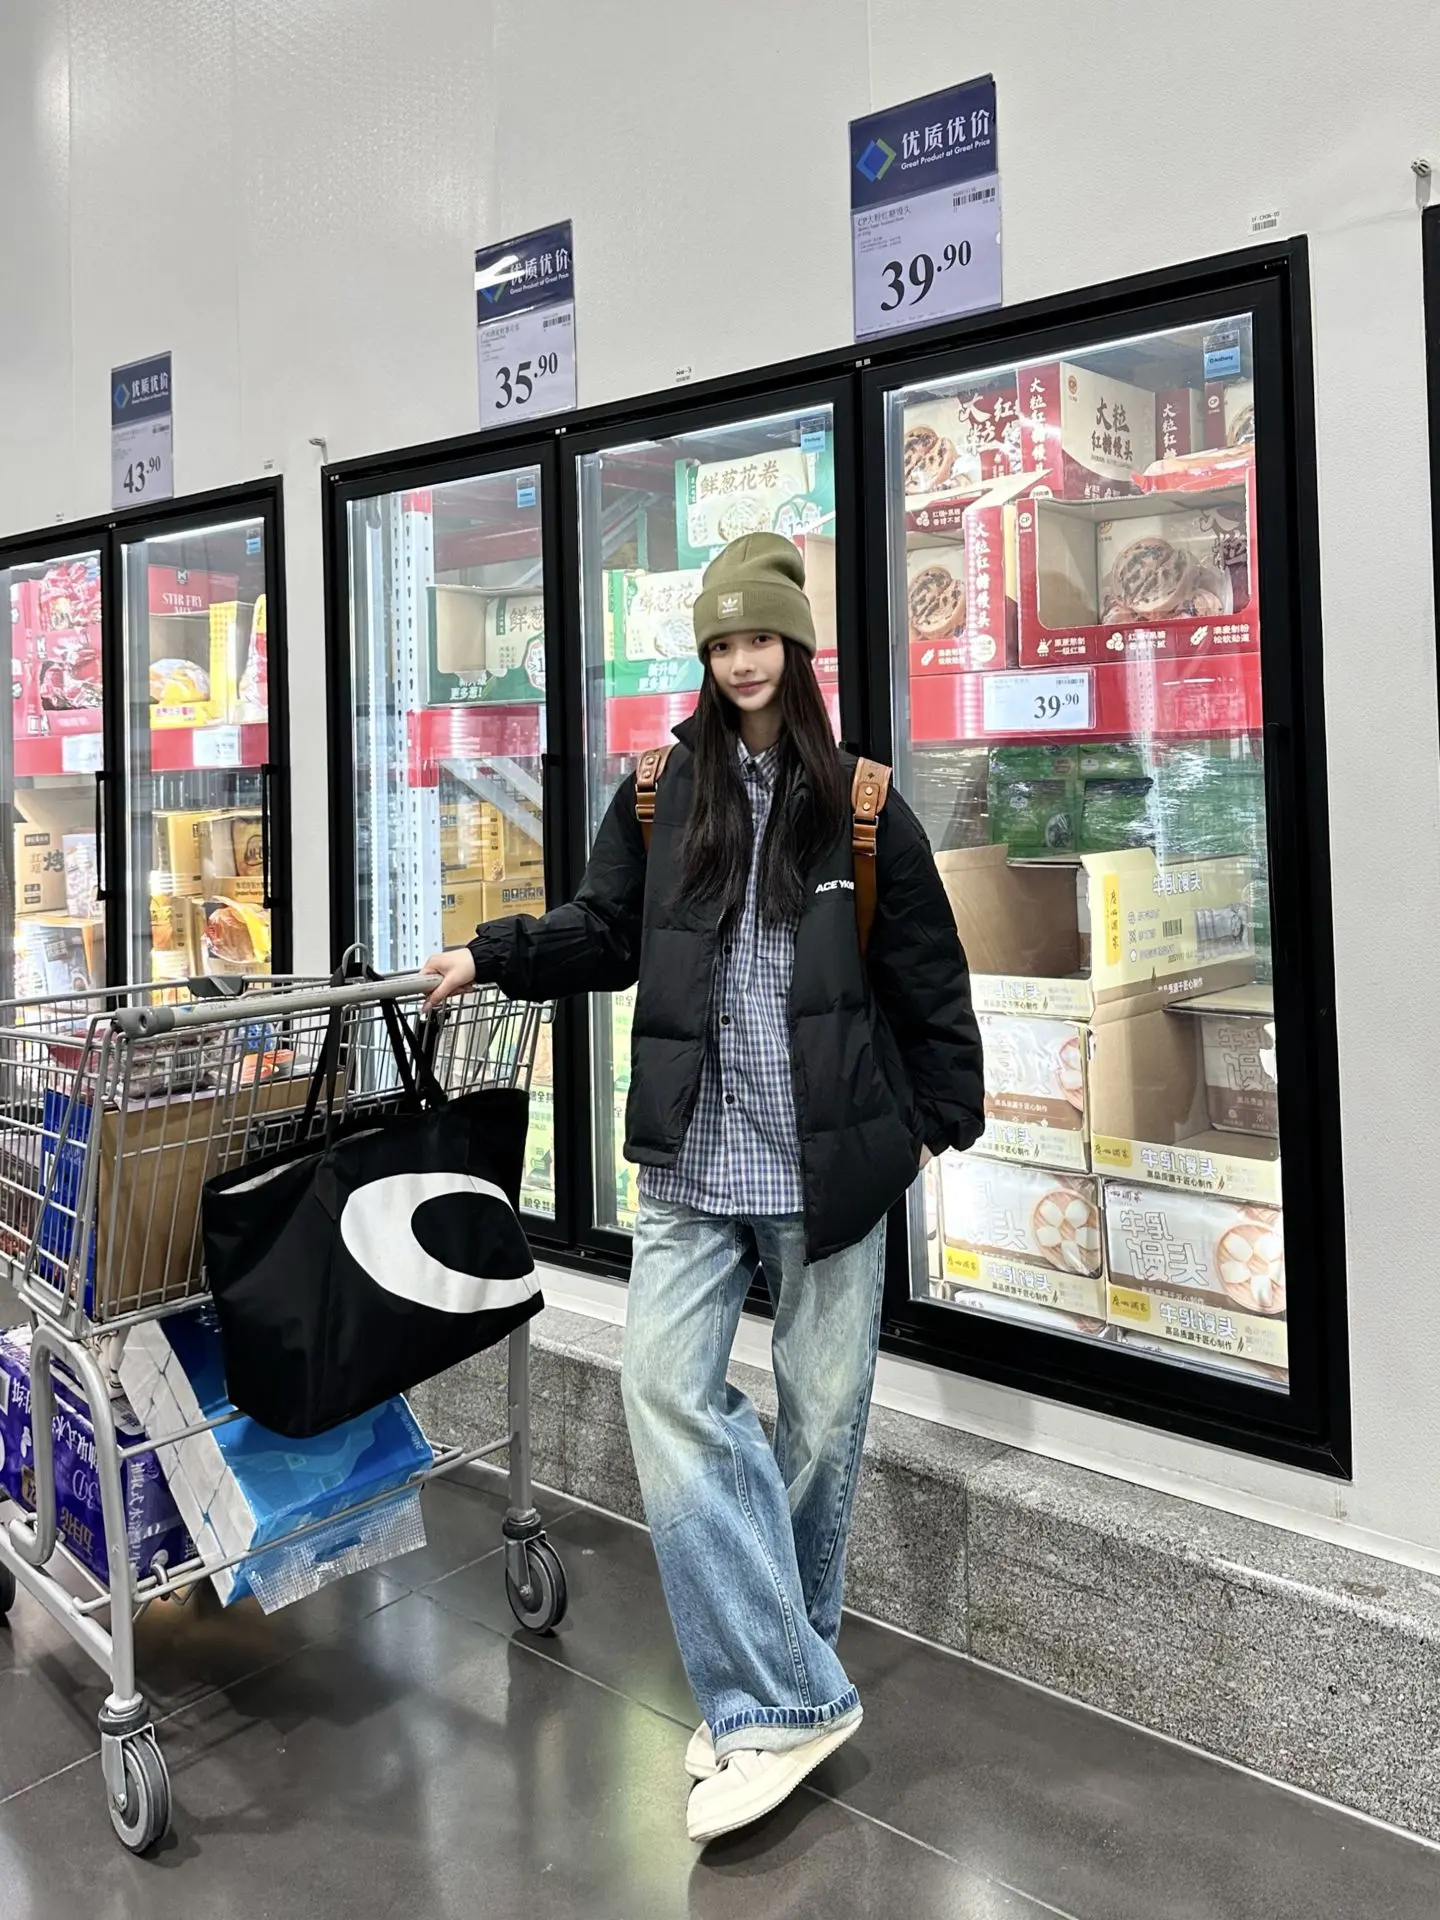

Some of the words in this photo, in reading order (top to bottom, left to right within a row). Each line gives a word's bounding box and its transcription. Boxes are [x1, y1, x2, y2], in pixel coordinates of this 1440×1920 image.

[901, 108, 990, 159] 优质优价
[901, 160, 920, 170] Great
[920, 153, 945, 167] Product
[954, 144, 973, 155] Great
[974, 138, 991, 148] Price
[510, 247, 569, 287] 优质优价
[880, 240, 972, 312] 39.90
[132, 371, 169, 398] 优质优价
[495, 352, 558, 409] 35.90
[1096, 396, 1130, 433] 大粒
[1091, 429, 1134, 463] 红糖馒头
[123, 455, 161, 494] 43.90
[700, 459, 780, 500] 鲜葱花卷
[975, 521, 991, 628] 大粒红糖馒头
[162, 592, 185, 606] STIR
[184, 595, 203, 608] FRY
[509, 605, 544, 633] 鲜葱
[449, 686, 483, 701] 更多葱!
[1033, 693, 1080, 719] 39.90
[815, 880, 838, 894] ACE
[1153, 870, 1202, 897] 牛乳馒头
[1140, 1147, 1218, 1179] 牛乳馒头
[1146, 1169, 1214, 1190] 高品质源于匠心制作
[1120, 1209, 1174, 1241] 牛乳
[988, 1262, 1051, 1292] 牛乳馒头
[1126, 1238, 1209, 1287] 馒头
[992, 1280, 1049, 1303] 高品质源于匠心制作
[1160, 1302, 1237, 1339] 牛乳馒头
[1165, 1324, 1233, 1351] 高品质源于匠心制作
[72, 1468, 99, 1510] 3D
[60, 1506, 95, 1553] 五月花
